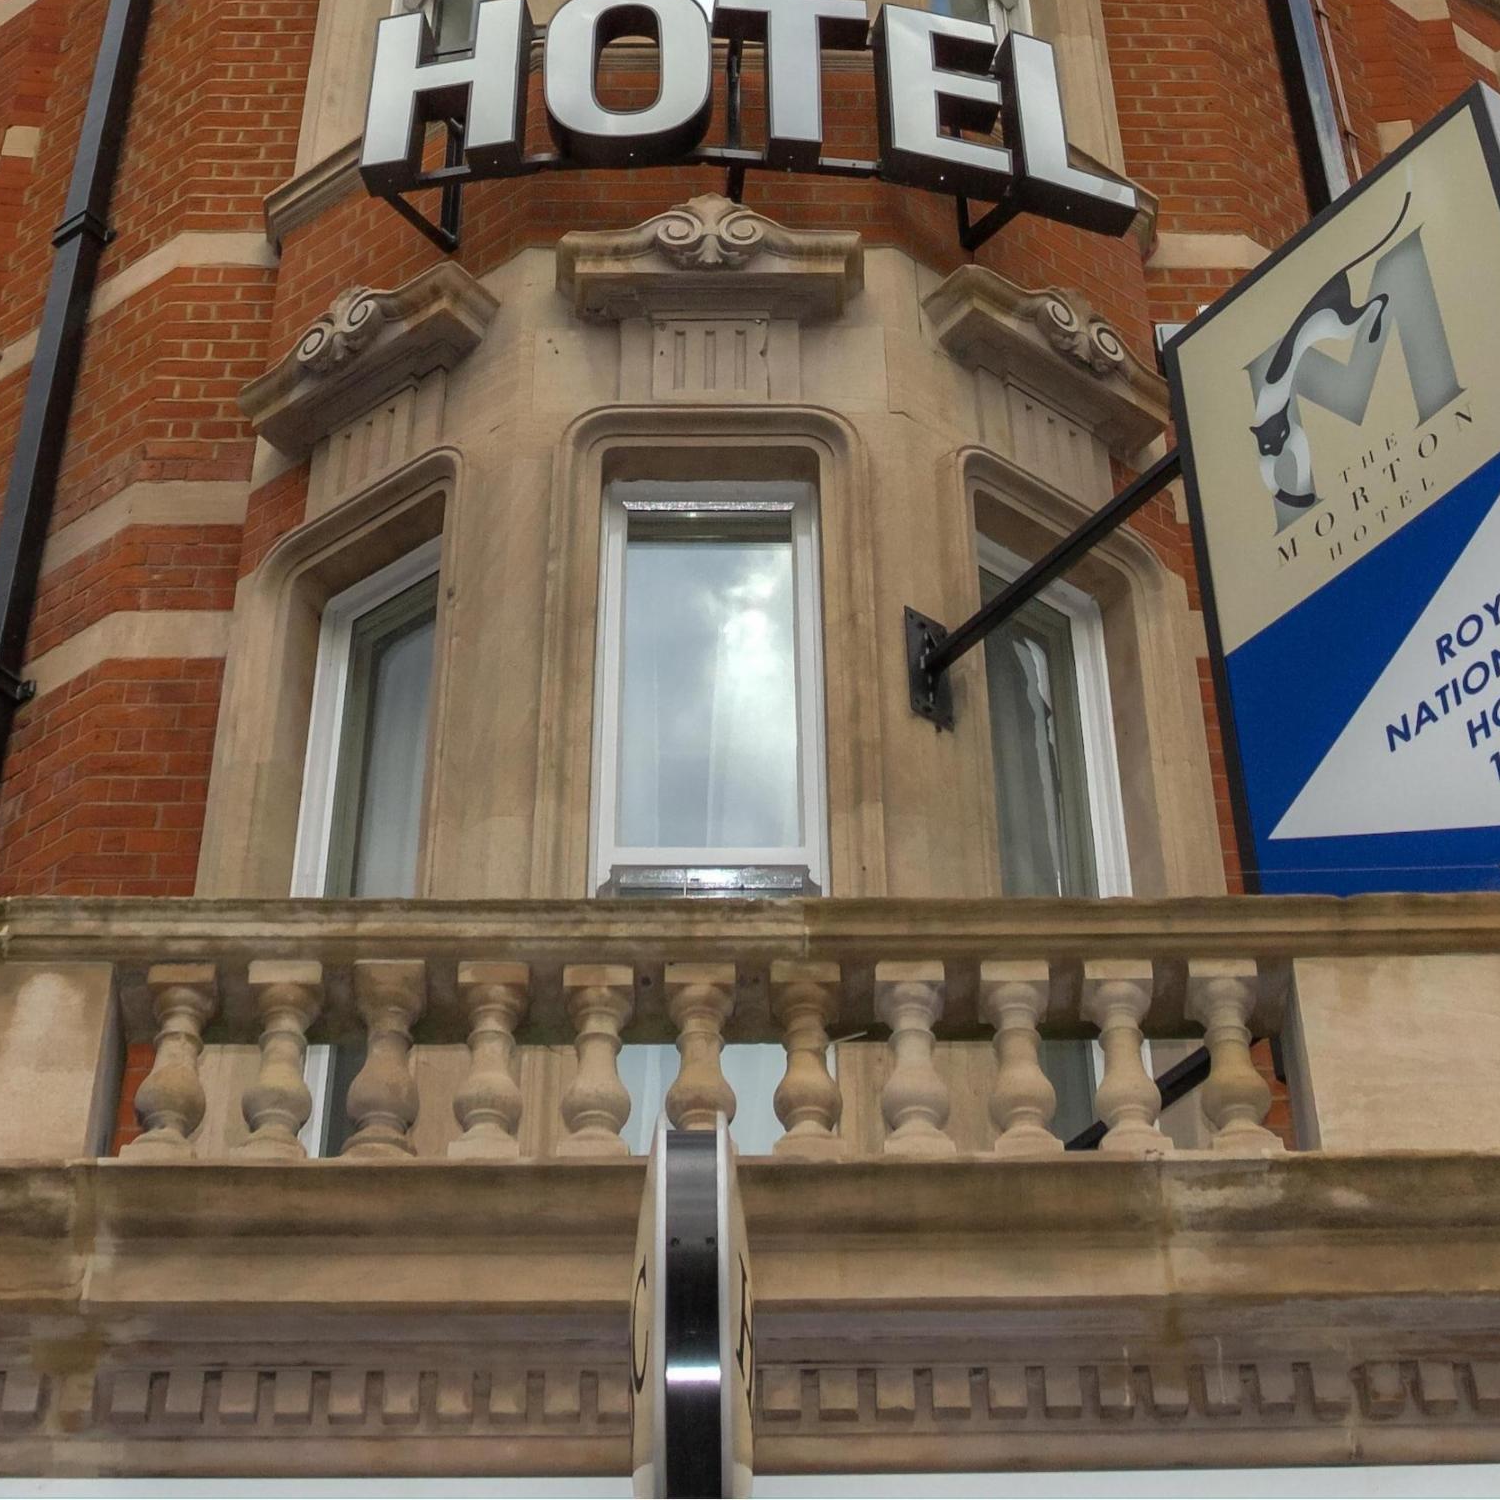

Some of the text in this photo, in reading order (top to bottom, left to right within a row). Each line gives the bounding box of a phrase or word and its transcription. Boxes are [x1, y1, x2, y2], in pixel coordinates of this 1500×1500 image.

[1277, 402, 1474, 569] MORTON
[1338, 432, 1398, 484] THE
[1329, 477, 1435, 562] HOTEL
